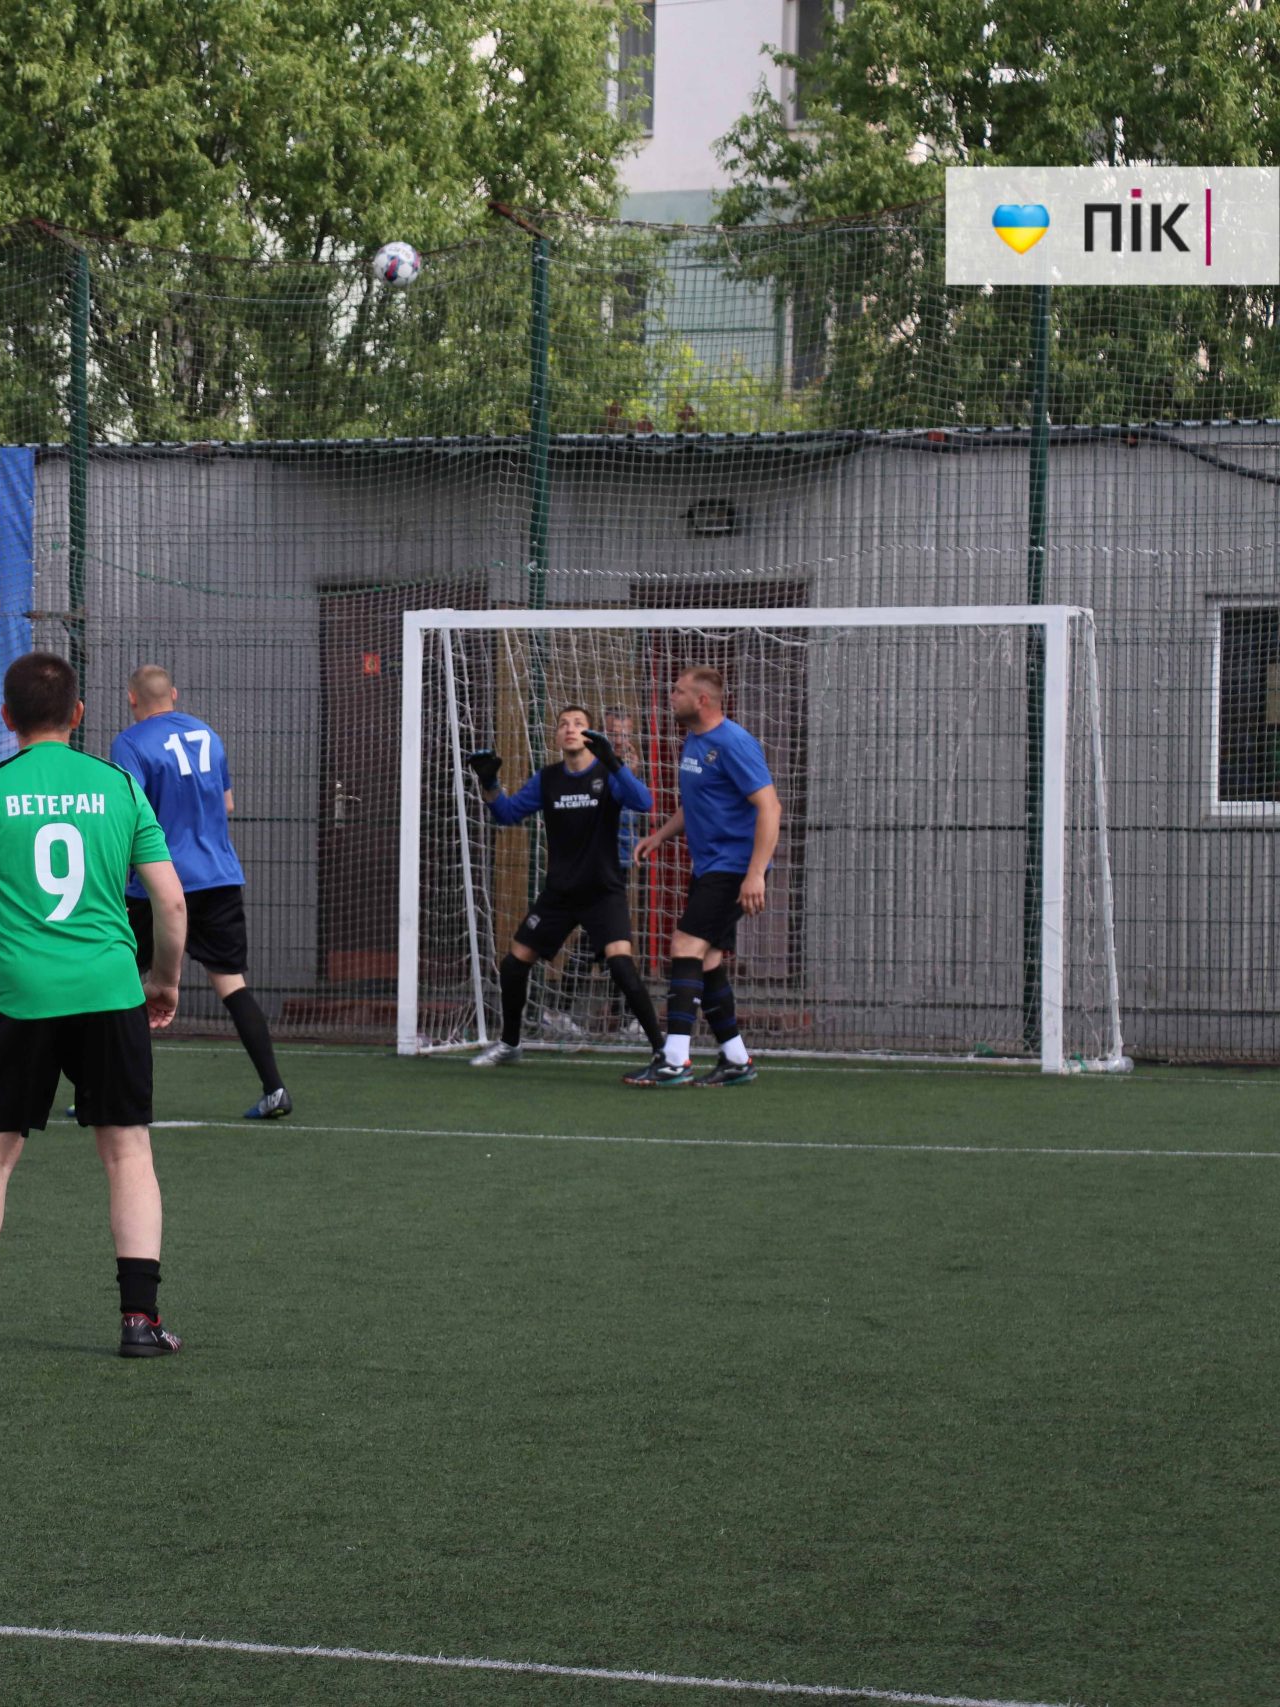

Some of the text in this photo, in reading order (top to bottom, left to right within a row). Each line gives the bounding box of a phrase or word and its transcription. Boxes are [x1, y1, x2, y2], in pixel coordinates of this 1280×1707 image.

[163, 729, 211, 776] 17
[5, 793, 105, 816] ВЕТЕРАН
[33, 822, 85, 921] 9
